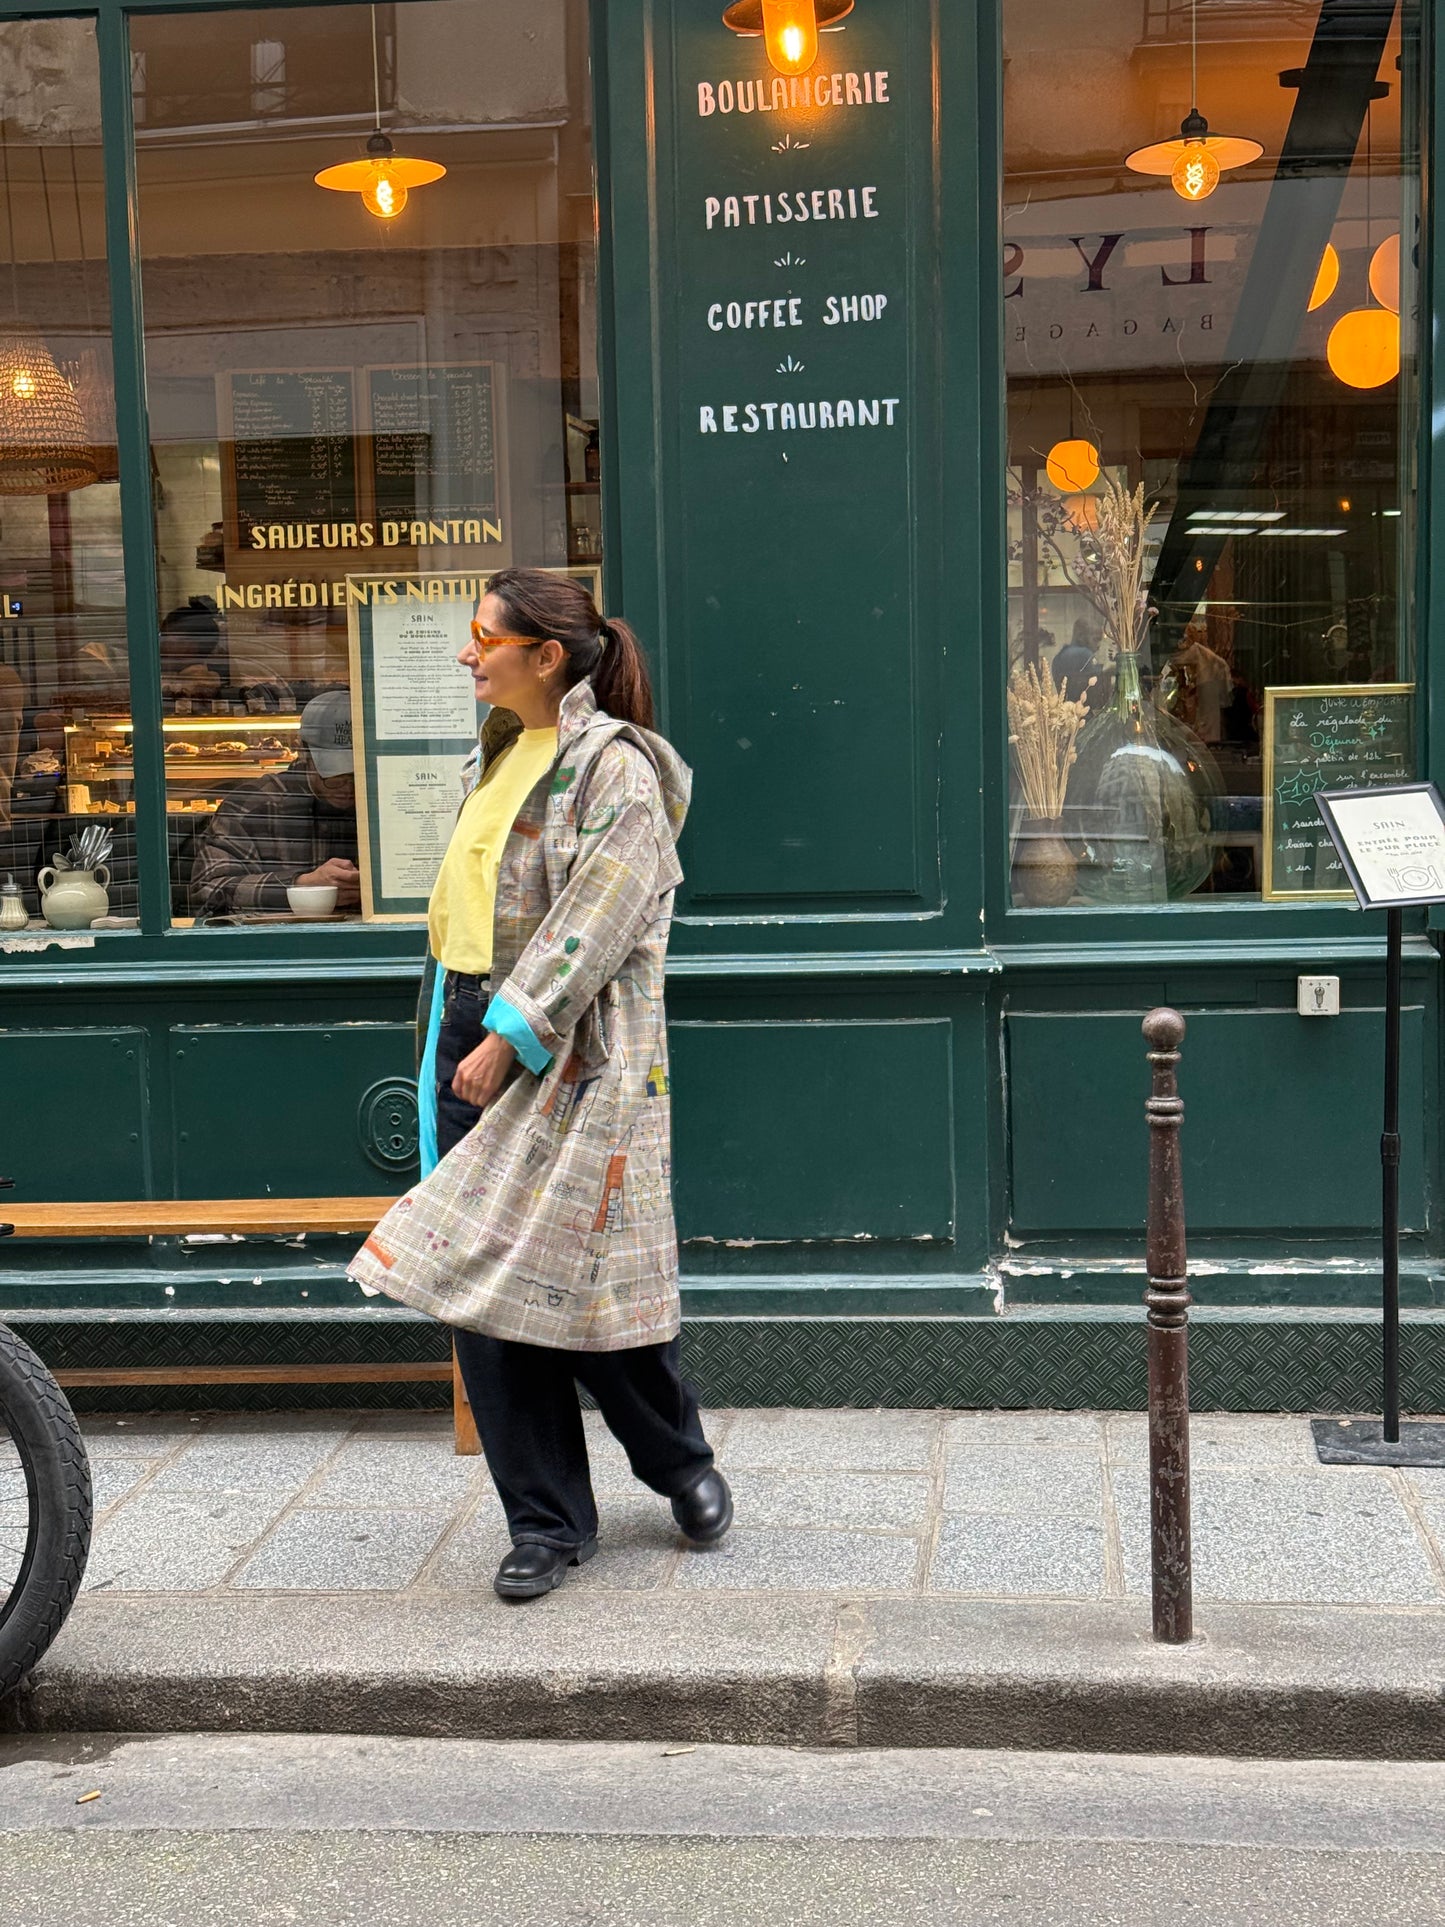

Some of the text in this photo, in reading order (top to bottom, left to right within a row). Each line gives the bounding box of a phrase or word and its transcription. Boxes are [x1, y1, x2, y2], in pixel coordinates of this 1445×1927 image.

[697, 71, 890, 117] BOULANGERIE
[705, 186, 879, 230] PATISSERIE
[707, 294, 888, 332] COFFEE SHOP
[700, 398, 900, 434] RESTAURANT
[251, 518, 502, 549] SAVEURS D'ANTAN
[215, 579, 398, 608] INGRÉDIENTS
[411, 614, 434, 623] SAIN
[1290, 712, 1308, 727] La
[1309, 731, 1364, 753] Déjeuner
[415, 773, 438, 781] SAIN
